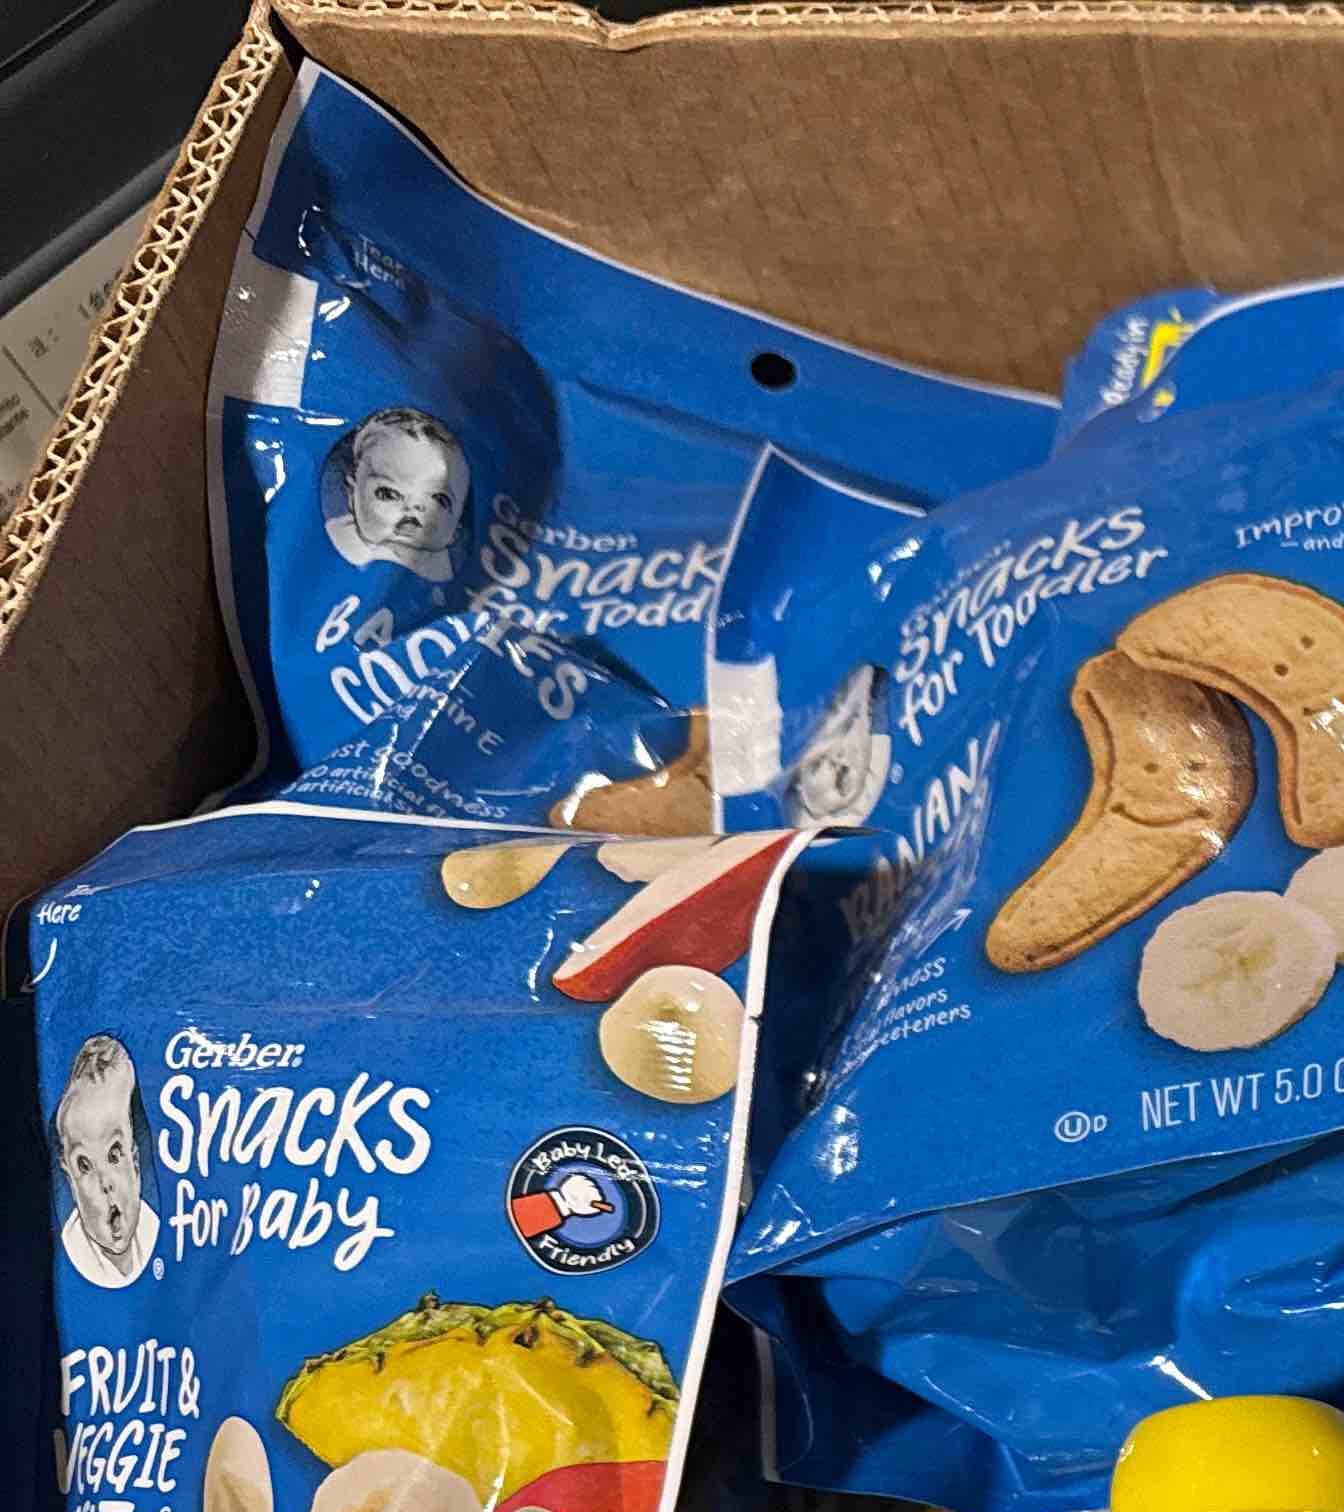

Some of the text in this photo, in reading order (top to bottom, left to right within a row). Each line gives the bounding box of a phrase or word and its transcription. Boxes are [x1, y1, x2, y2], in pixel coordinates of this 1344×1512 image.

[897, 506, 1145, 680] Snacks
[899, 547, 1166, 741] for Toddler
[158, 1074, 430, 1177] Snacks
[1142, 1090, 1205, 1132] NET
[1212, 1077, 1266, 1117] WT
[1275, 1062, 1324, 1105] 5.0
[533, 1141, 637, 1181] Baby Led
[169, 1181, 394, 1271] for Baby
[539, 1235, 635, 1266] Friendly
[61, 1338, 176, 1417] FRUIT
[54, 1420, 188, 1494] VEGGIE
